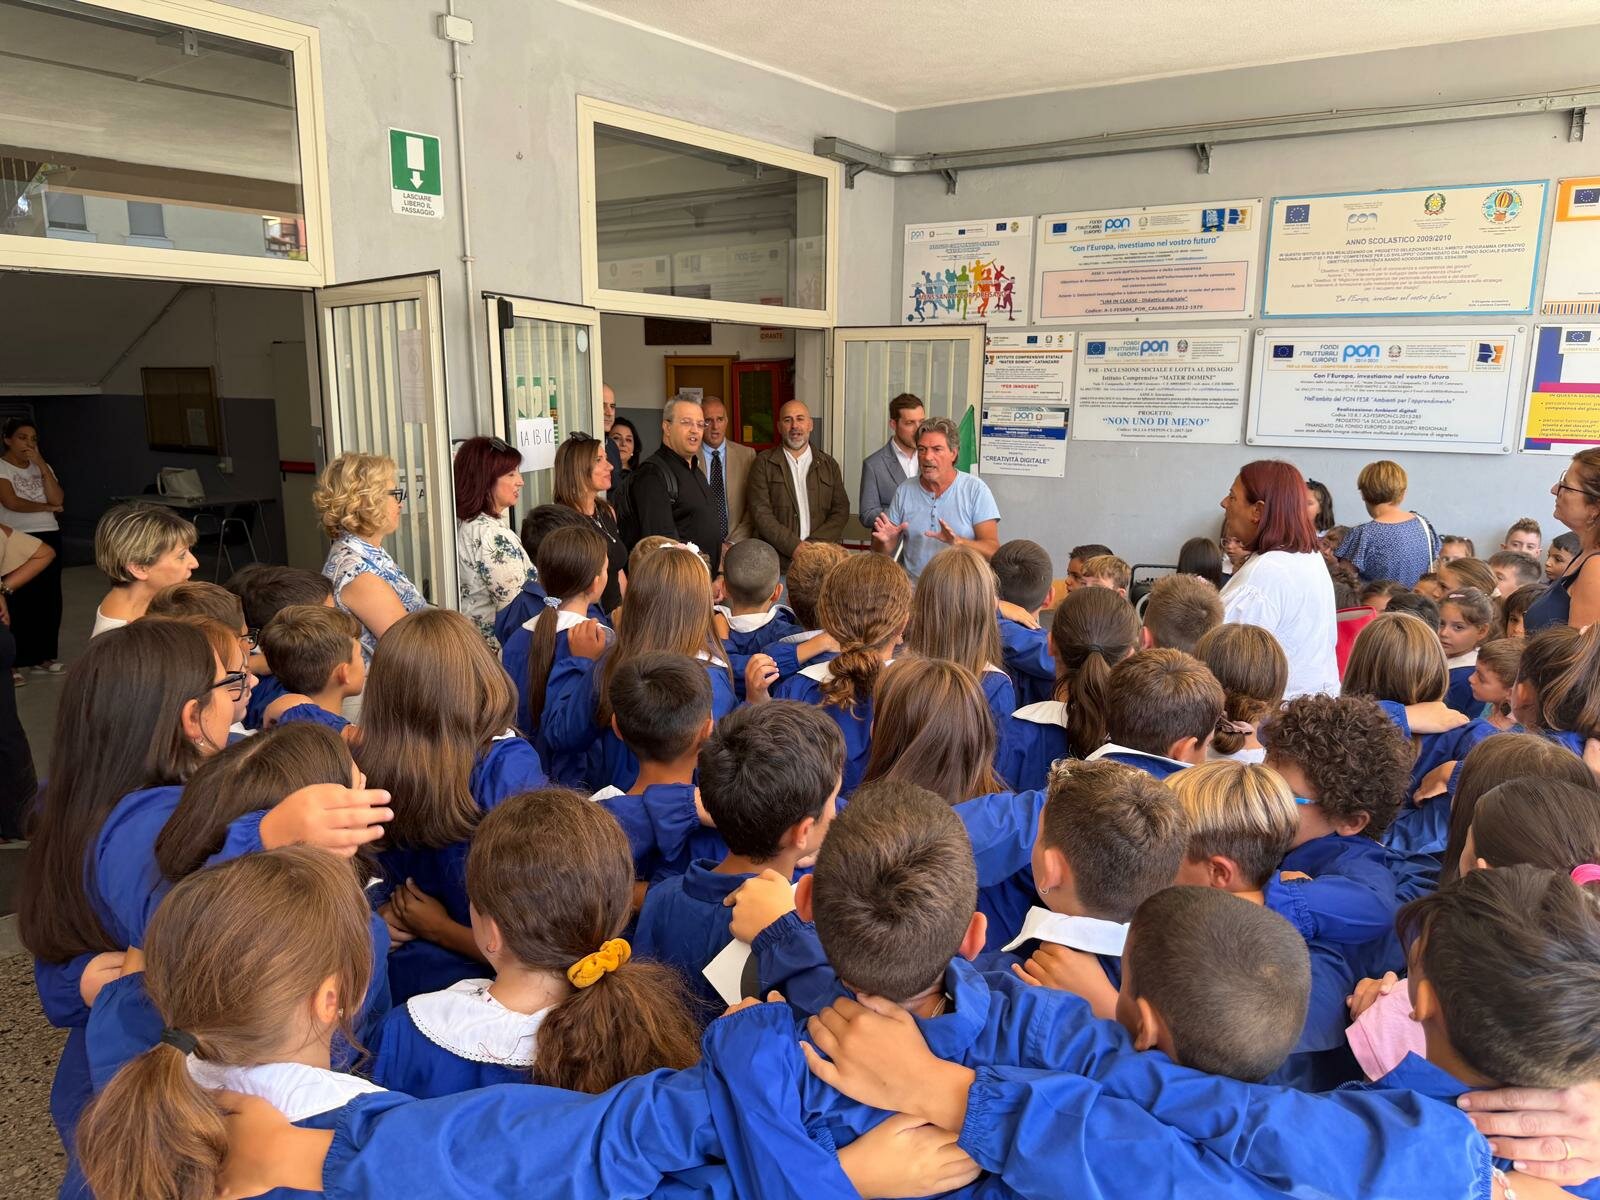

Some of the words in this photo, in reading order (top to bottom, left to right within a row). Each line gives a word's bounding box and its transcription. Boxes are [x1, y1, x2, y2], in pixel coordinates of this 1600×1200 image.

[403, 193, 432, 202] LASCIARE
[404, 200, 425, 208] LIBERO
[402, 207, 435, 216] PASSAGGIO
[1104, 217, 1130, 233] pon
[1368, 236, 1414, 245] SCOLASTICO
[1416, 234, 1452, 243] 2009/2010
[1087, 243, 1116, 252] l'Europa,
[1118, 240, 1155, 250] investiamo
[1169, 238, 1192, 247] vostro
[1140, 340, 1169, 357] pon
[1342, 344, 1380, 362] pon
[1014, 411, 1033, 421] pon
[1103, 417, 1129, 425] "NON
[1132, 417, 1154, 426] UNO
[1157, 417, 1168, 426] DI
[1171, 417, 1210, 426] MENO"
